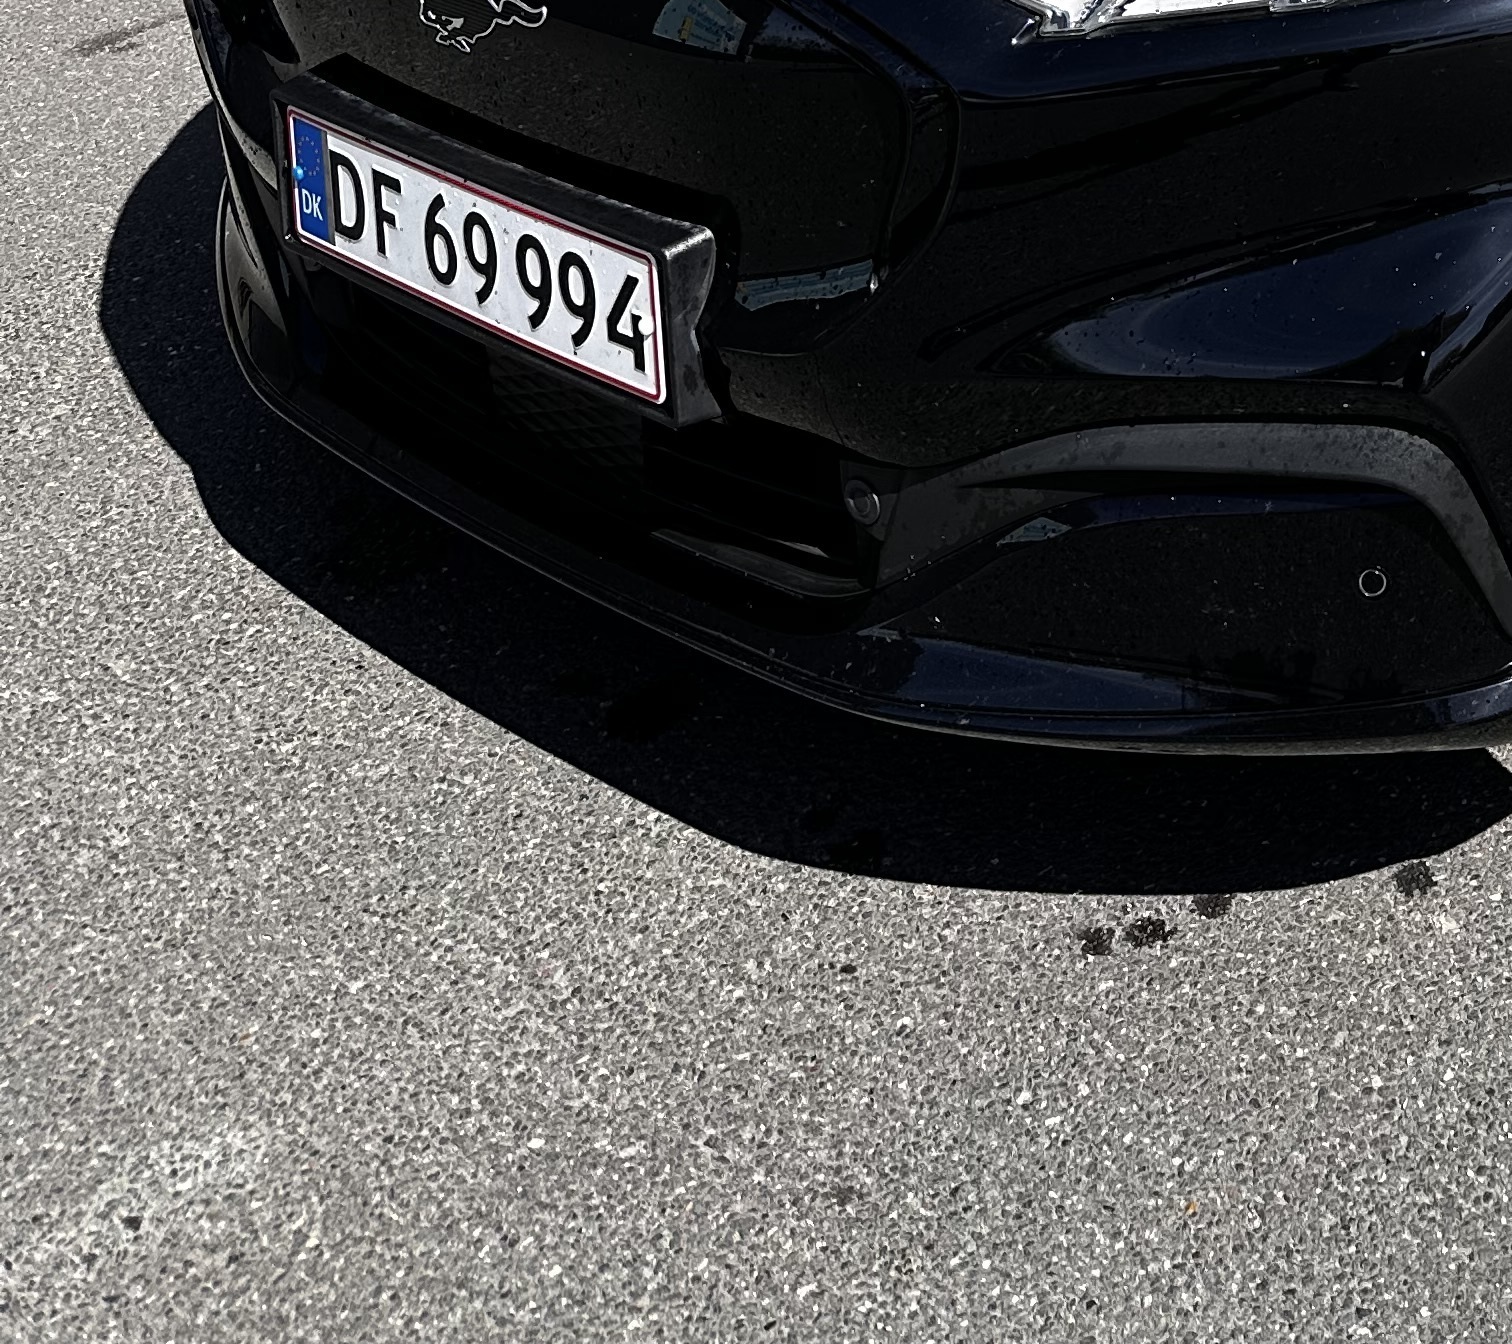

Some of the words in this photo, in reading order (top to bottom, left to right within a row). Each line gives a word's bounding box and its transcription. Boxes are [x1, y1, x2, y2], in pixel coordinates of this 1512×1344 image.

[301, 187, 323, 222] DK
[330, 149, 402, 259] DF
[424, 193, 498, 306] 69
[515, 232, 648, 374] 994
